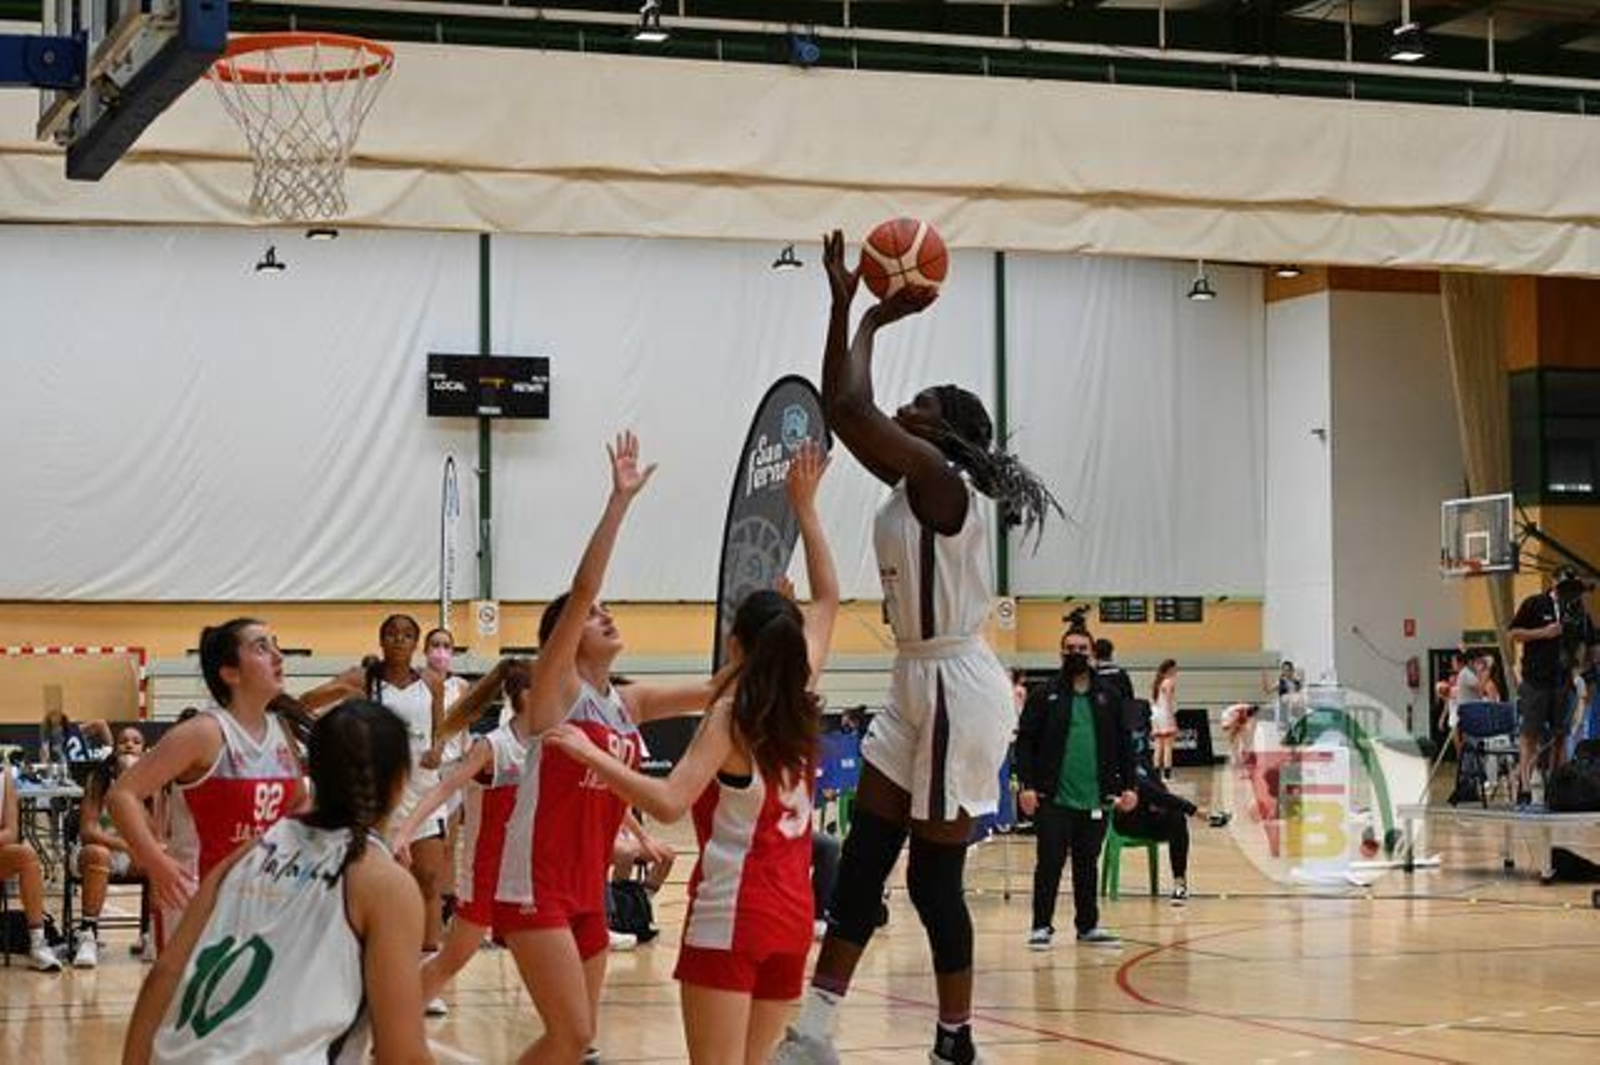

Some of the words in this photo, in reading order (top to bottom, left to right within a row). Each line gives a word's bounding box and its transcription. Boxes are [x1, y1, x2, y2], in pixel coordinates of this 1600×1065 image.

[433, 380, 467, 392] LOCAL
[756, 433, 783, 465] San
[254, 782, 283, 821] 92
[175, 934, 274, 1040] 10
